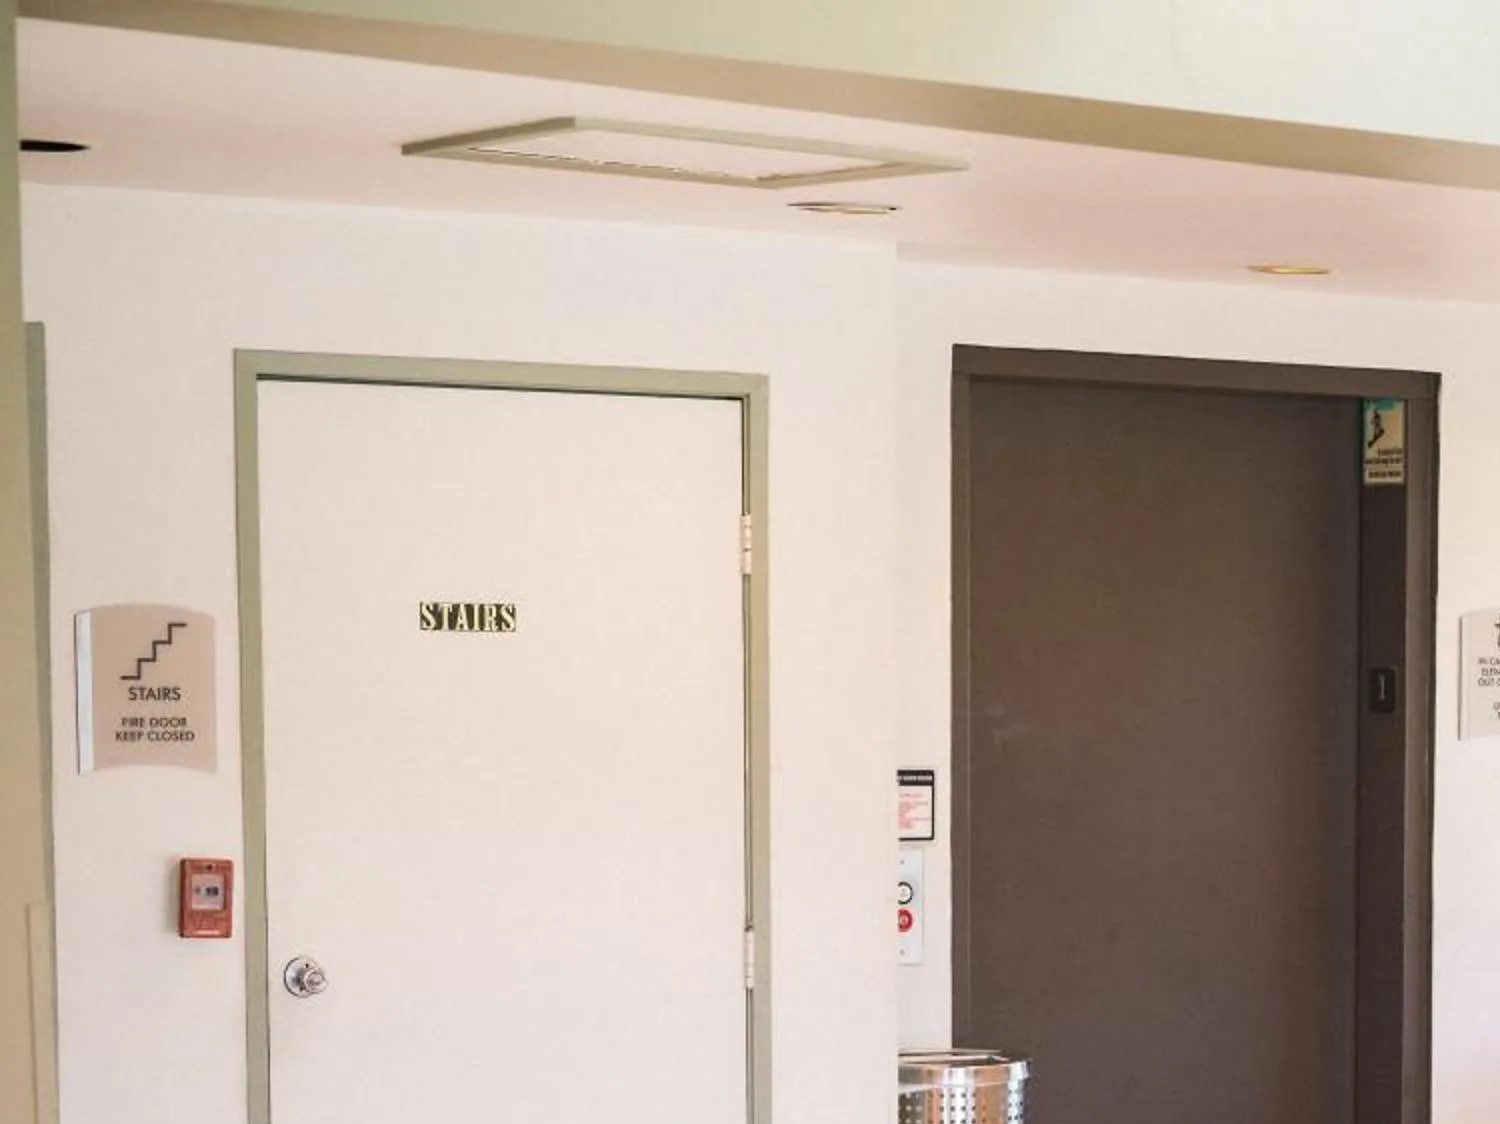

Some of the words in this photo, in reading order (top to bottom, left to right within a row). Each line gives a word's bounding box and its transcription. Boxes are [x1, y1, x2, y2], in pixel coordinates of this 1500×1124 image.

[420, 602, 516, 632] STAIRS
[128, 686, 181, 701] STAIRS
[121, 717, 145, 728] FIRE
[149, 717, 187, 728] DOOR
[115, 730, 144, 742] KEEP
[147, 730, 195, 742] CLOSED
